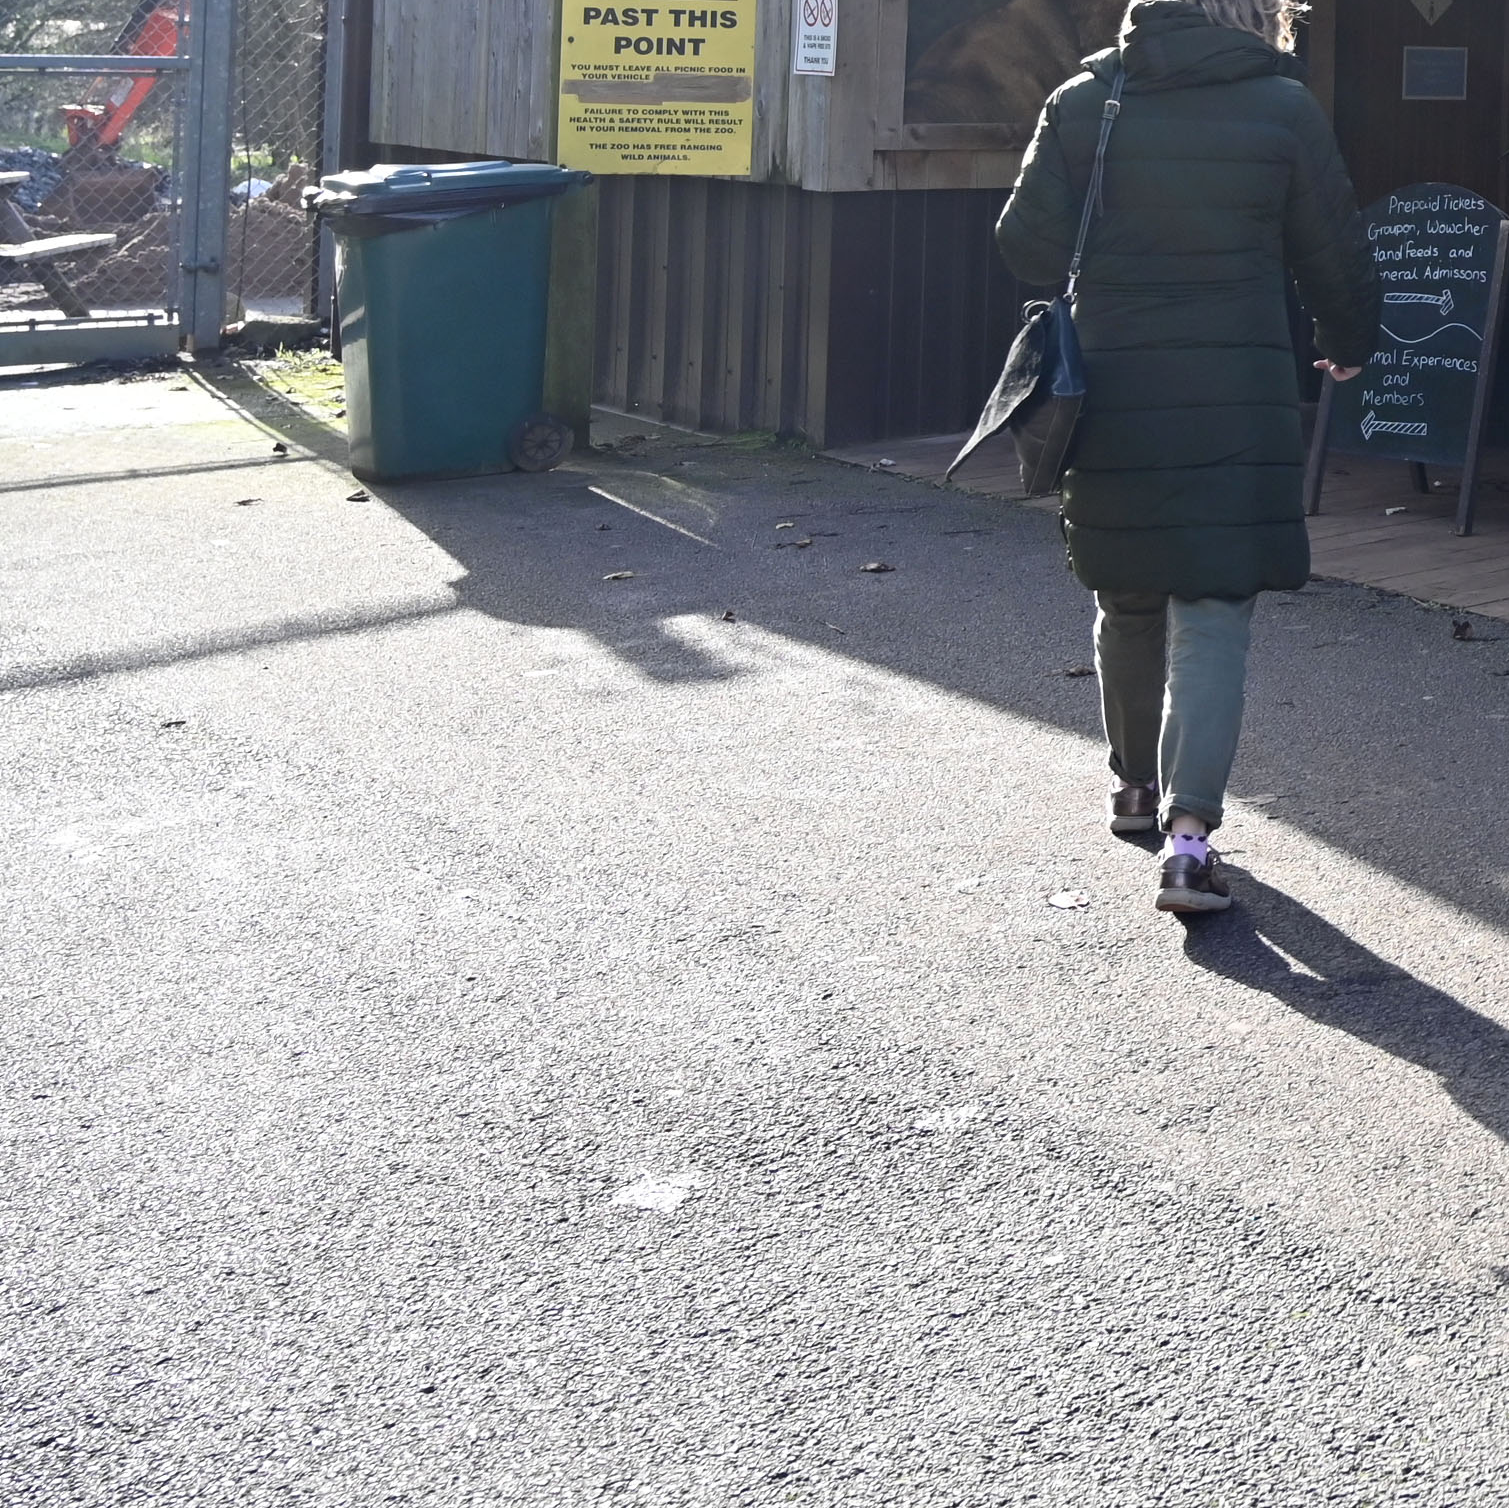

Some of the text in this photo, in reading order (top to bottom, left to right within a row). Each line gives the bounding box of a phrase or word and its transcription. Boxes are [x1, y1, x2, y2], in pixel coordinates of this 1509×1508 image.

[584, 7, 737, 28] PAST THIS
[614, 37, 705, 55] POINT
[1389, 194, 1484, 214] Prepaid Tickets
[1368, 216, 1488, 240] Groupon, Wowcher
[1449, 245, 1473, 258] and
[1424, 266, 1487, 282] Admissons
[1402, 350, 1477, 372] Experiences
[1383, 372, 1409, 386] and
[1362, 390, 1424, 406] Members
